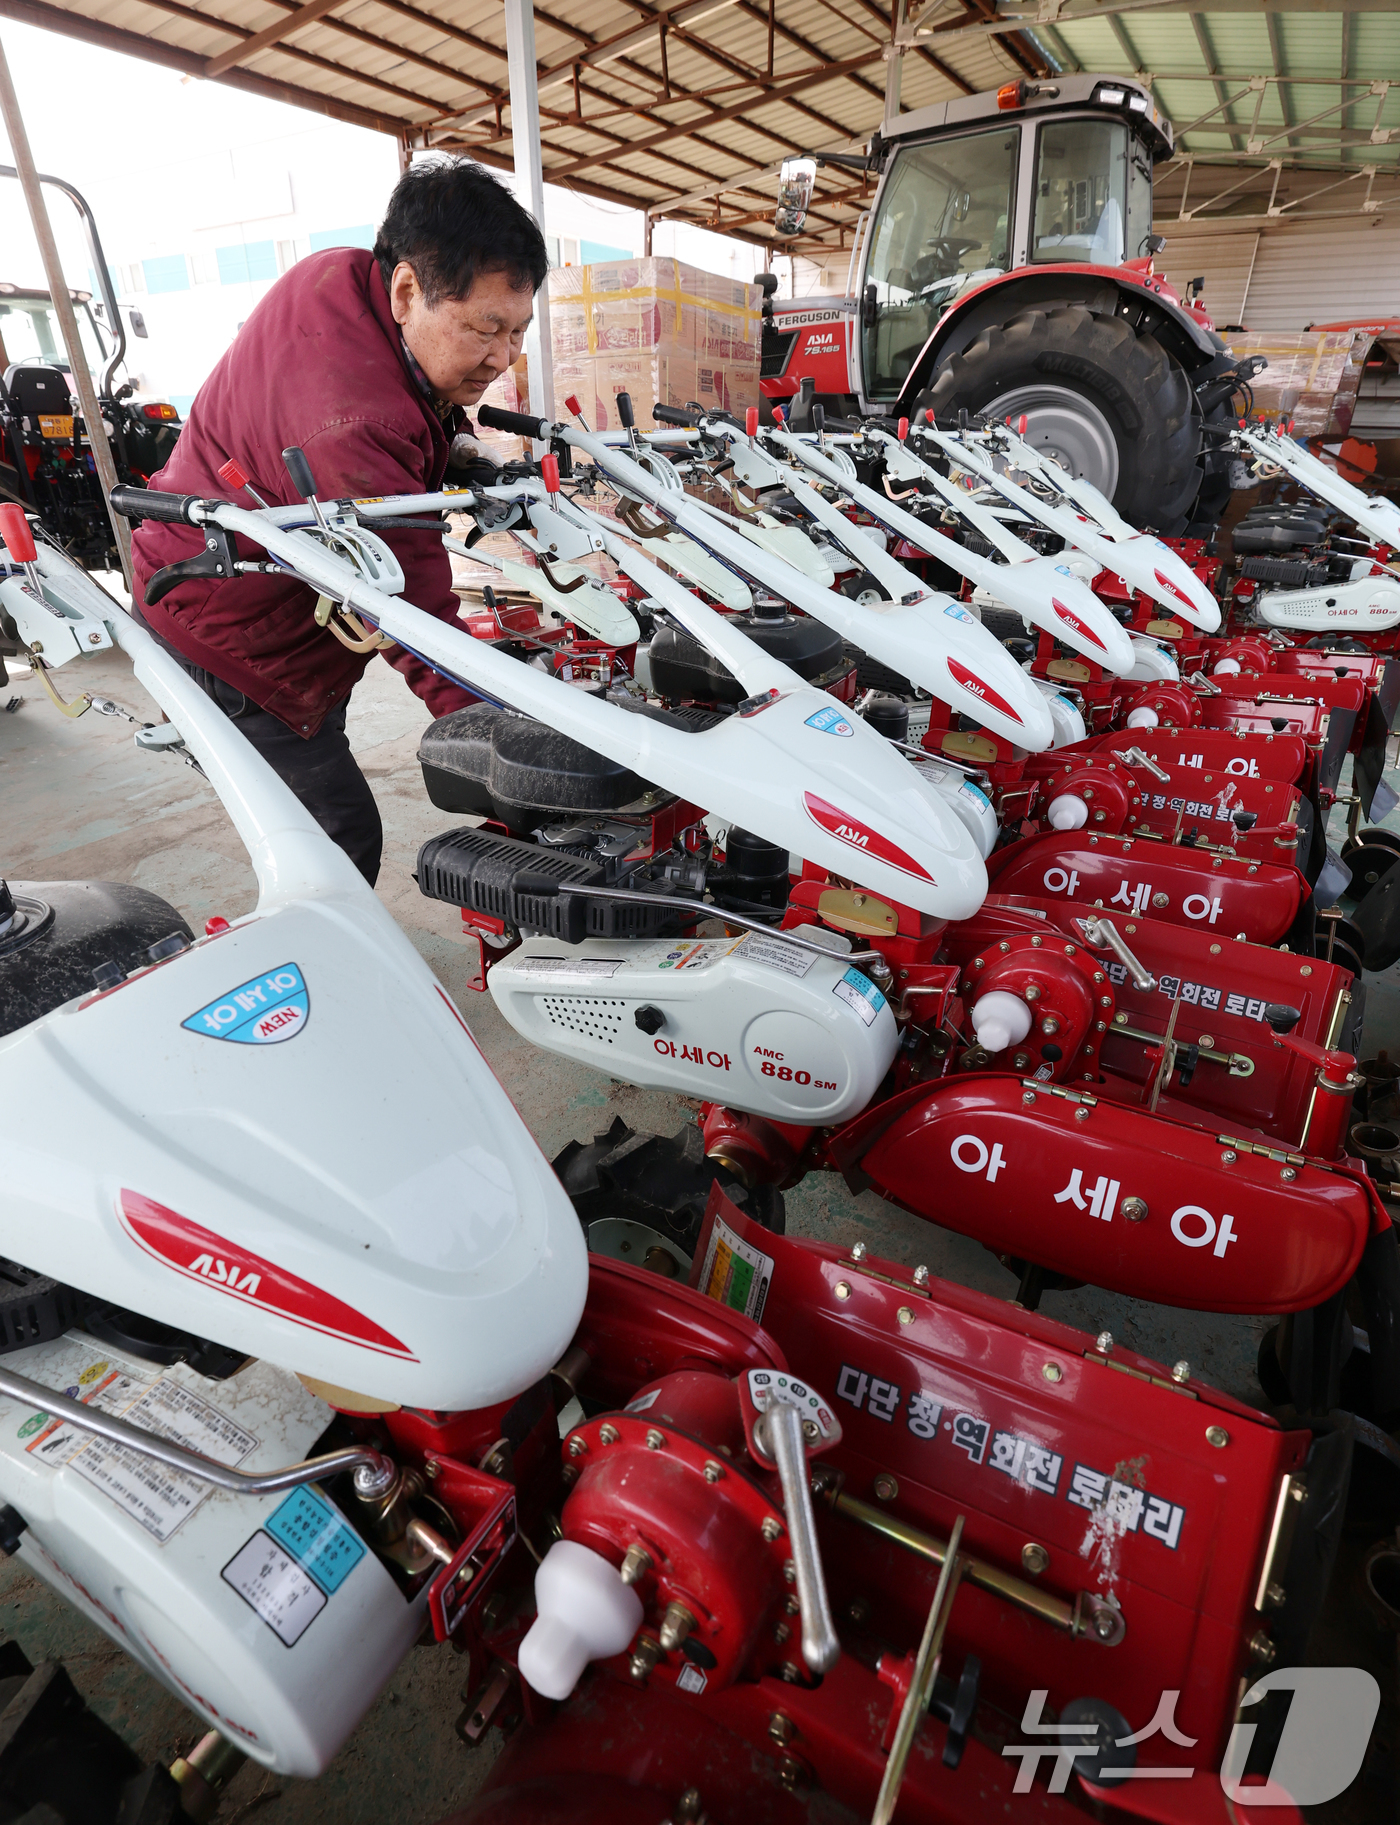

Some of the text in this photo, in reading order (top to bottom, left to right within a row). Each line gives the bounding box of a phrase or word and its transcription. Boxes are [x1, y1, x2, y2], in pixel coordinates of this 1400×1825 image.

[779, 310, 840, 326] FERGUSON
[807, 333, 833, 345] ASIA
[1043, 356, 1120, 401] MULTIBIB
[1163, 582, 1177, 594] ASIA
[1063, 615, 1080, 629] ASIA
[963, 680, 986, 697] ASIA
[834, 824, 869, 847] ASIA
[203, 973, 297, 1031] 아세아
[1224, 992, 1270, 1023] 로타
[259, 1007, 300, 1037] NEW
[653, 1038, 732, 1071] 아세아
[753, 1046, 785, 1061] AMC
[760, 1061, 837, 1091] 880 SM
[188, 1253, 262, 1295] ASIA
[836, 1362, 901, 1424] 다단
